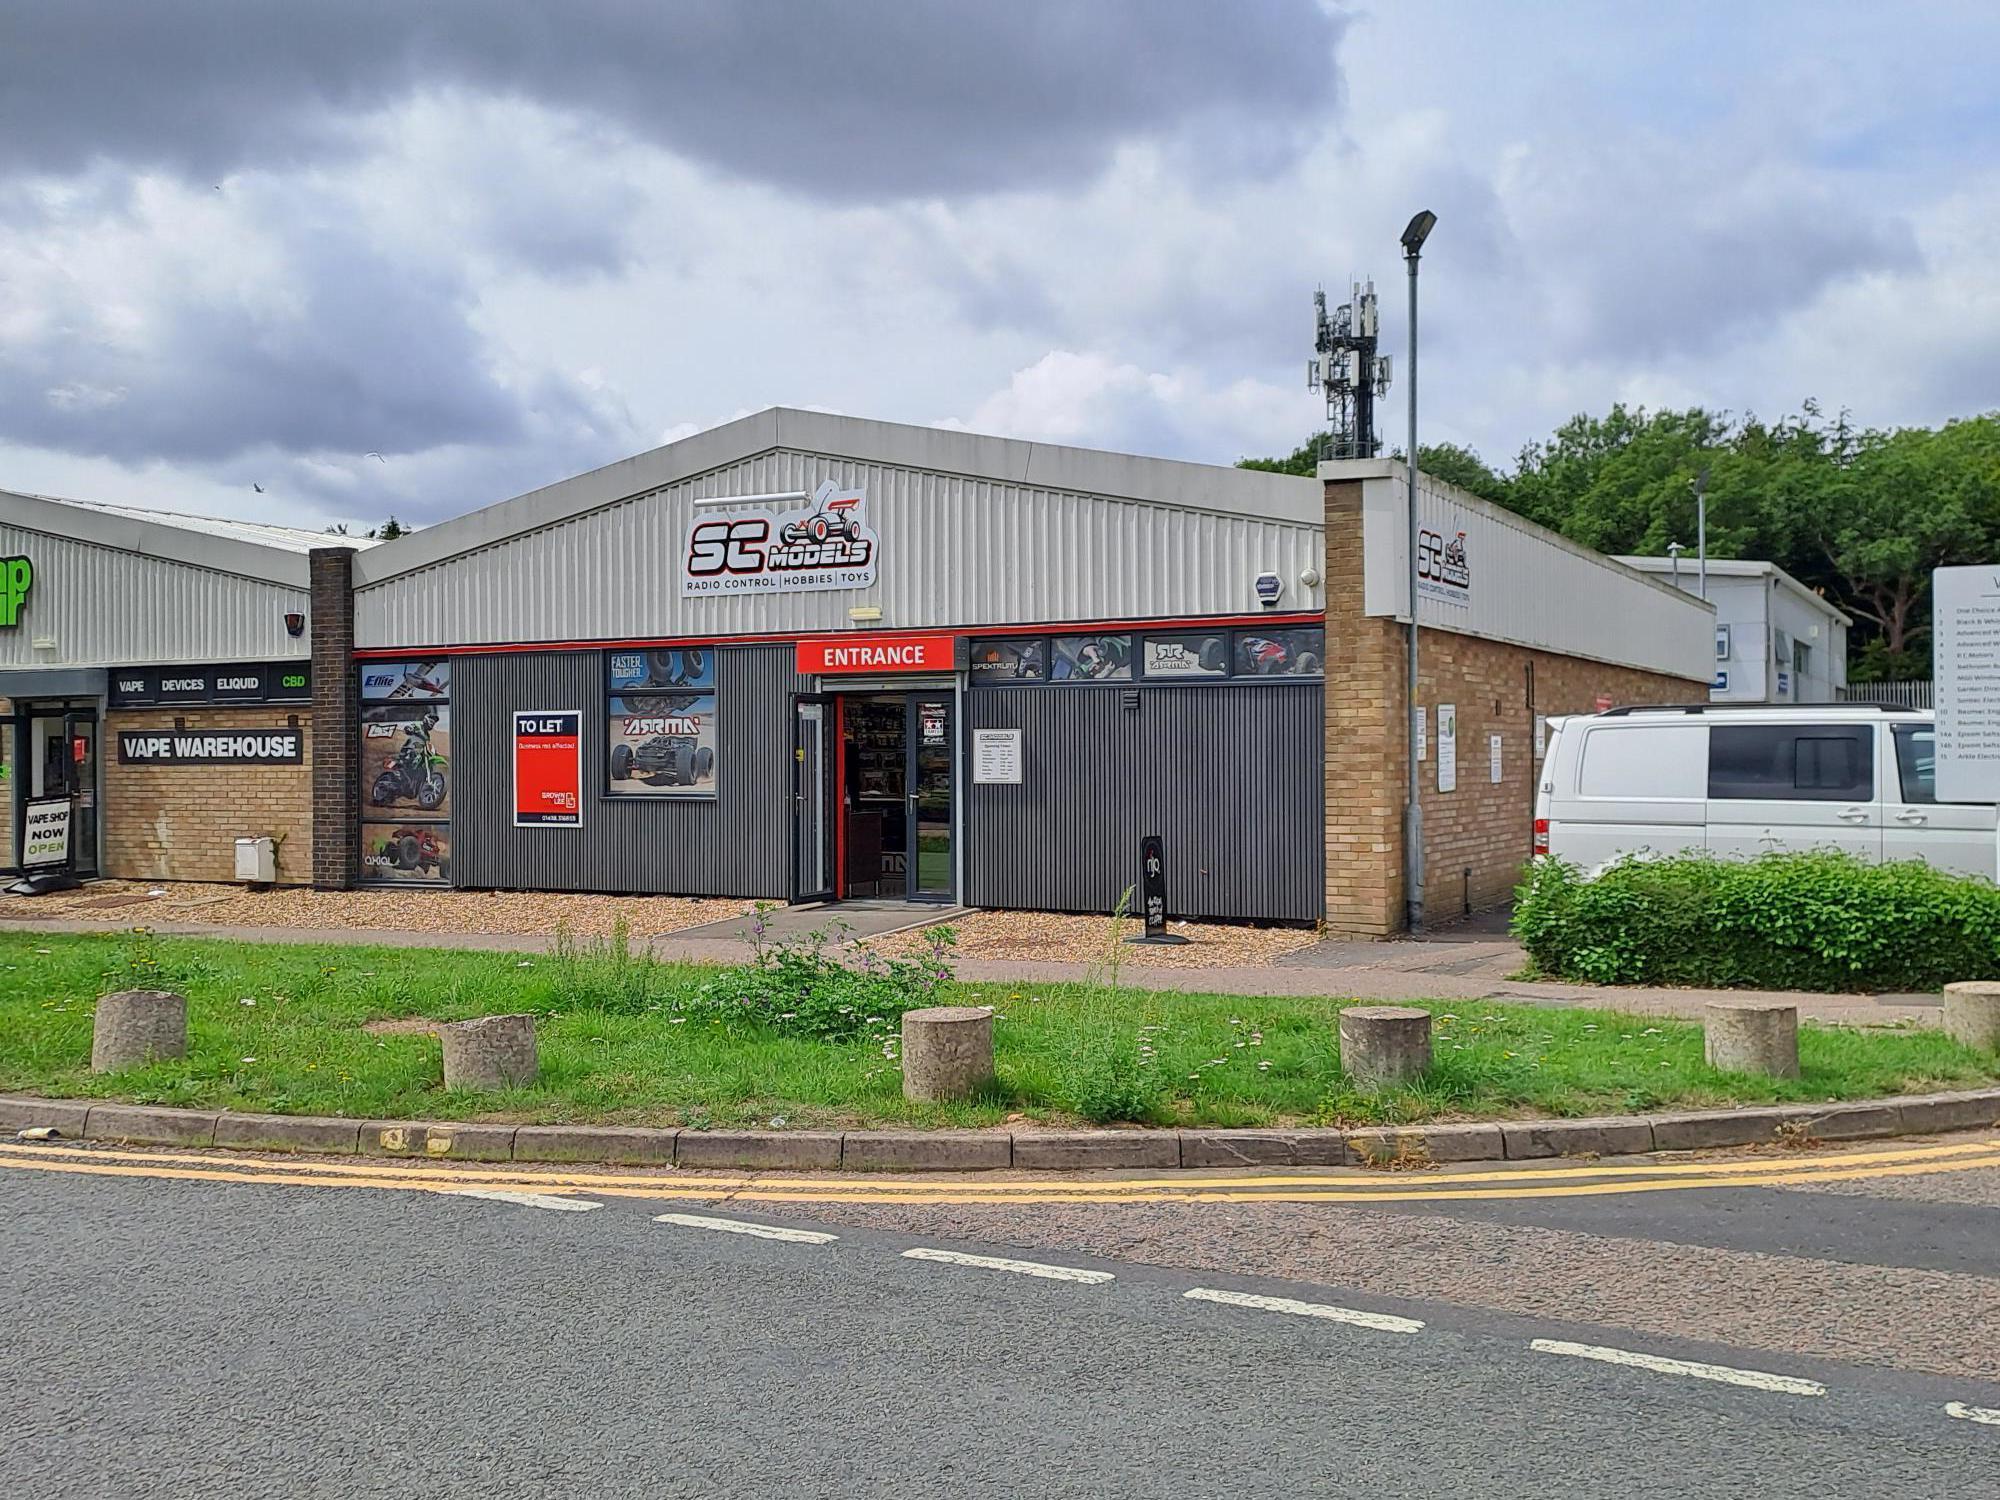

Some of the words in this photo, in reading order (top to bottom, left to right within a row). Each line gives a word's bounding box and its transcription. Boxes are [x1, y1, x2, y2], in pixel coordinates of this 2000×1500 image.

[688, 519, 769, 576] SC
[768, 539, 872, 571] MODELS
[687, 580, 720, 590] RADIO
[725, 578, 776, 589] CONTROL
[784, 575, 832, 585] HOBBIES
[841, 572, 870, 582] TOYS
[824, 646, 925, 667] ENTRANCE
[119, 680, 145, 692] VAPE
[162, 679, 205, 692] DEVICES
[217, 677, 259, 690] ELIQUID
[282, 675, 305, 688] CBD
[519, 720, 536, 733] TO
[540, 719, 563, 733] LET
[124, 738, 171, 758] VAPE
[174, 736, 297, 758] WAREHOUSE
[28, 812, 49, 825] VAPE
[50, 811, 69, 823] SHOP
[31, 828, 65, 840] NOW
[28, 841, 65, 855] OPEN
